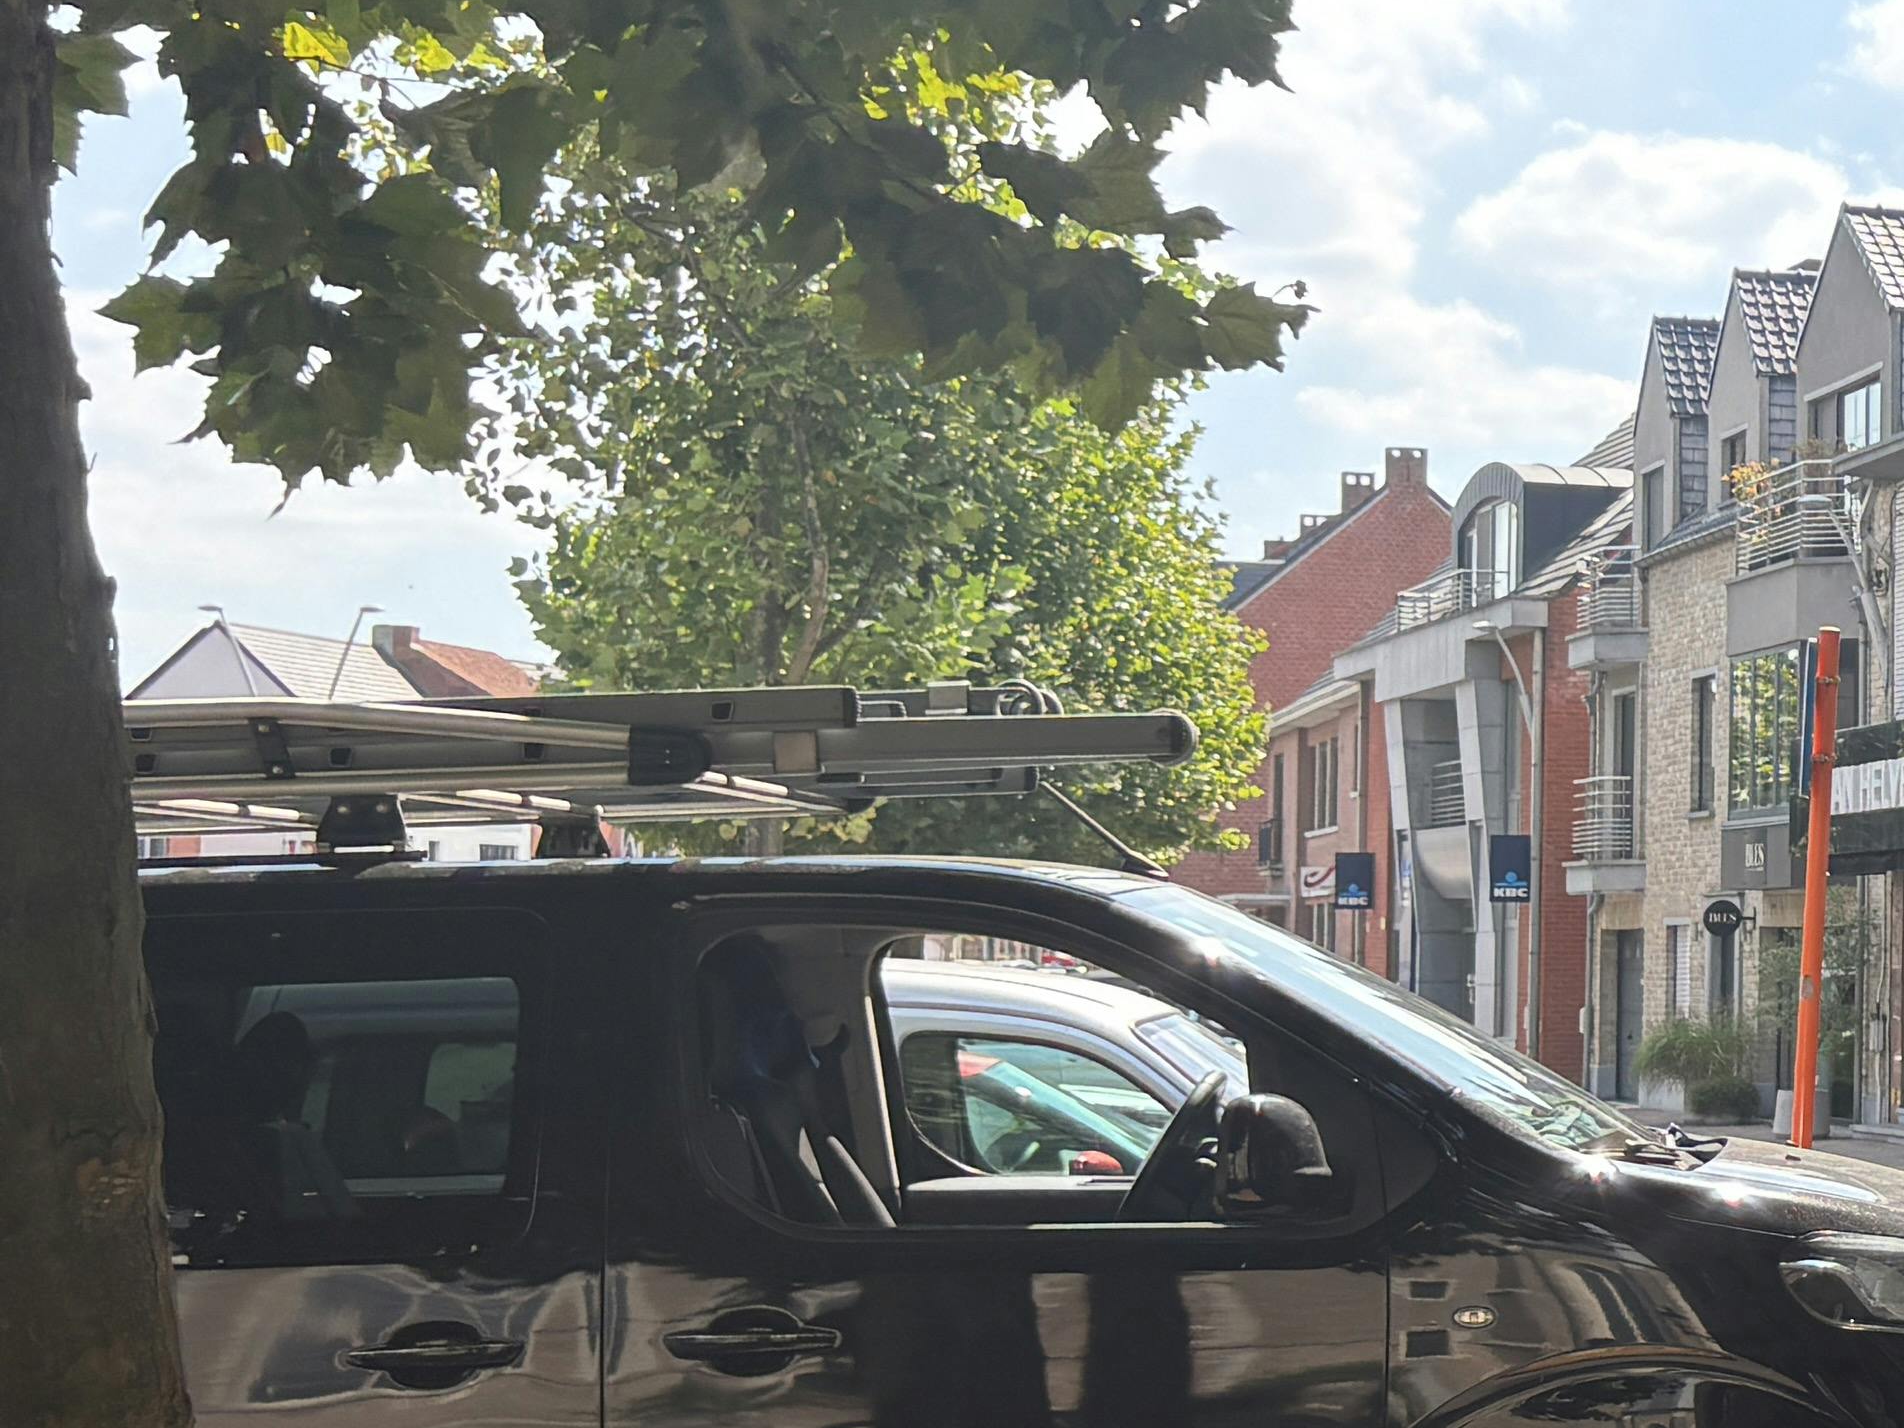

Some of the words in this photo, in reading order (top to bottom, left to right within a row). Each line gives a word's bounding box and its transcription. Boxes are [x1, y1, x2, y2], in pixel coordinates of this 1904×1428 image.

[1831, 765, 1855, 816] AN
[1493, 887, 1528, 897] KBC
[1337, 897, 1369, 906] KBC
